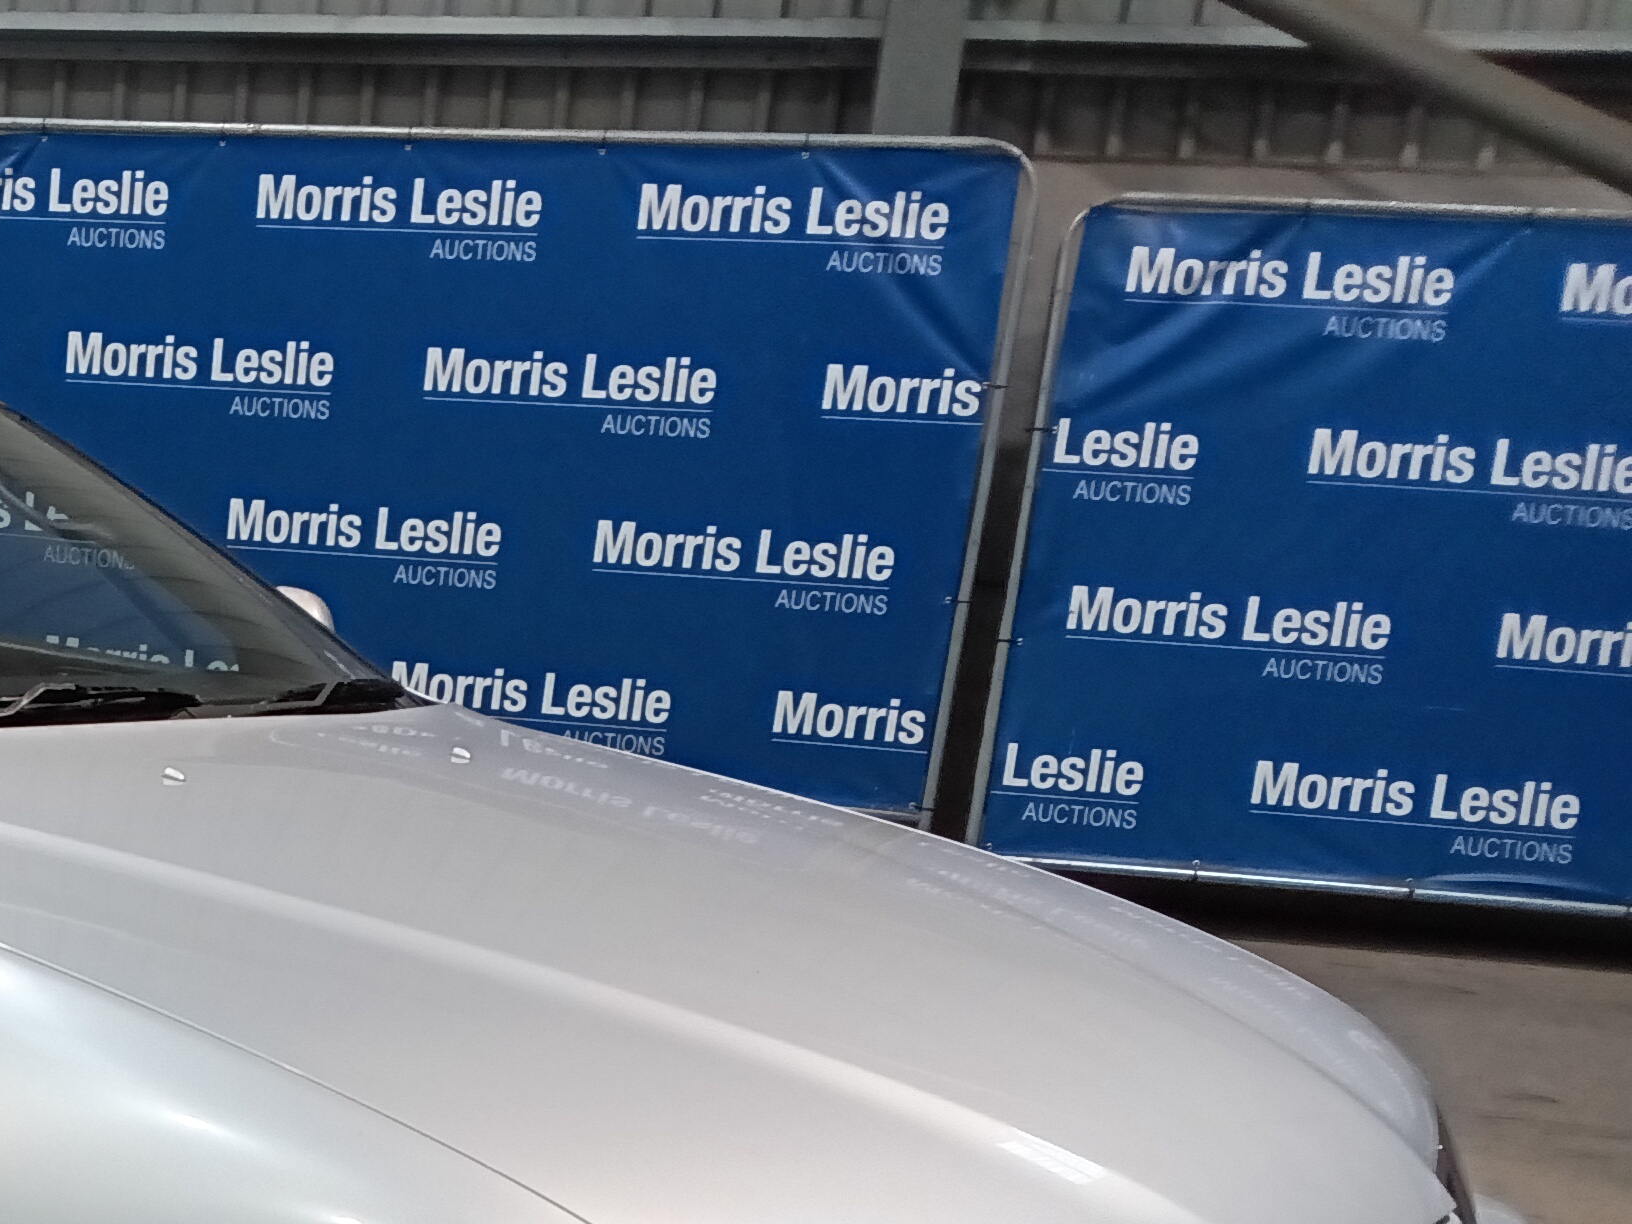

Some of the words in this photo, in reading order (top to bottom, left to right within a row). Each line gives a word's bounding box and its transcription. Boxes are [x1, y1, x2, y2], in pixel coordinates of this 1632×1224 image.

[49, 168, 168, 216] Leslie
[257, 174, 396, 222] Morris
[411, 178, 542, 227] Leslie
[638, 184, 791, 234] Morris
[806, 187, 949, 240] Leslie
[67, 227, 165, 249] AUCTIONS
[430, 239, 536, 261] AUCTIONS
[826, 251, 942, 276] AUCTIONS
[1126, 246, 1288, 298] Morris
[1303, 252, 1454, 306] Leslie
[1324, 315, 1446, 342] AUCTIONS
[66, 331, 197, 380] Morris
[211, 338, 333, 386] Leslie
[424, 347, 567, 397] Morris
[582, 354, 716, 404] Leslie
[230, 396, 329, 419] AUCTIONS
[822, 364, 980, 416] Morris
[601, 414, 710, 438] AUCTIONS
[1053, 418, 1198, 470] Leslie
[1308, 428, 1475, 483] Morris
[1491, 439, 1632, 494] Leslie
[1073, 480, 1191, 505] AUCTIONS
[227, 498, 361, 547] Morris
[375, 507, 501, 556] Leslie
[593, 520, 741, 571] Morris
[756, 529, 894, 581] Leslie
[44, 544, 135, 570] AUCTION
[394, 565, 496, 589] AUCTIONS
[775, 589, 887, 615] AUCTIONS
[1067, 585, 1227, 639] Morris
[1242, 596, 1391, 650] Leslie
[392, 661, 527, 713] Morris
[541, 673, 670, 723] Leslie
[1262, 658, 1383, 684] AUCTIONS
[773, 691, 925, 744] Morris
[1003, 743, 1143, 795] Leslie
[1251, 760, 1415, 816] Morris
[1430, 774, 1579, 829] Leslie
[1022, 802, 1136, 829] AUCTIONS
[1450, 836, 1572, 864] AUCTIONS
